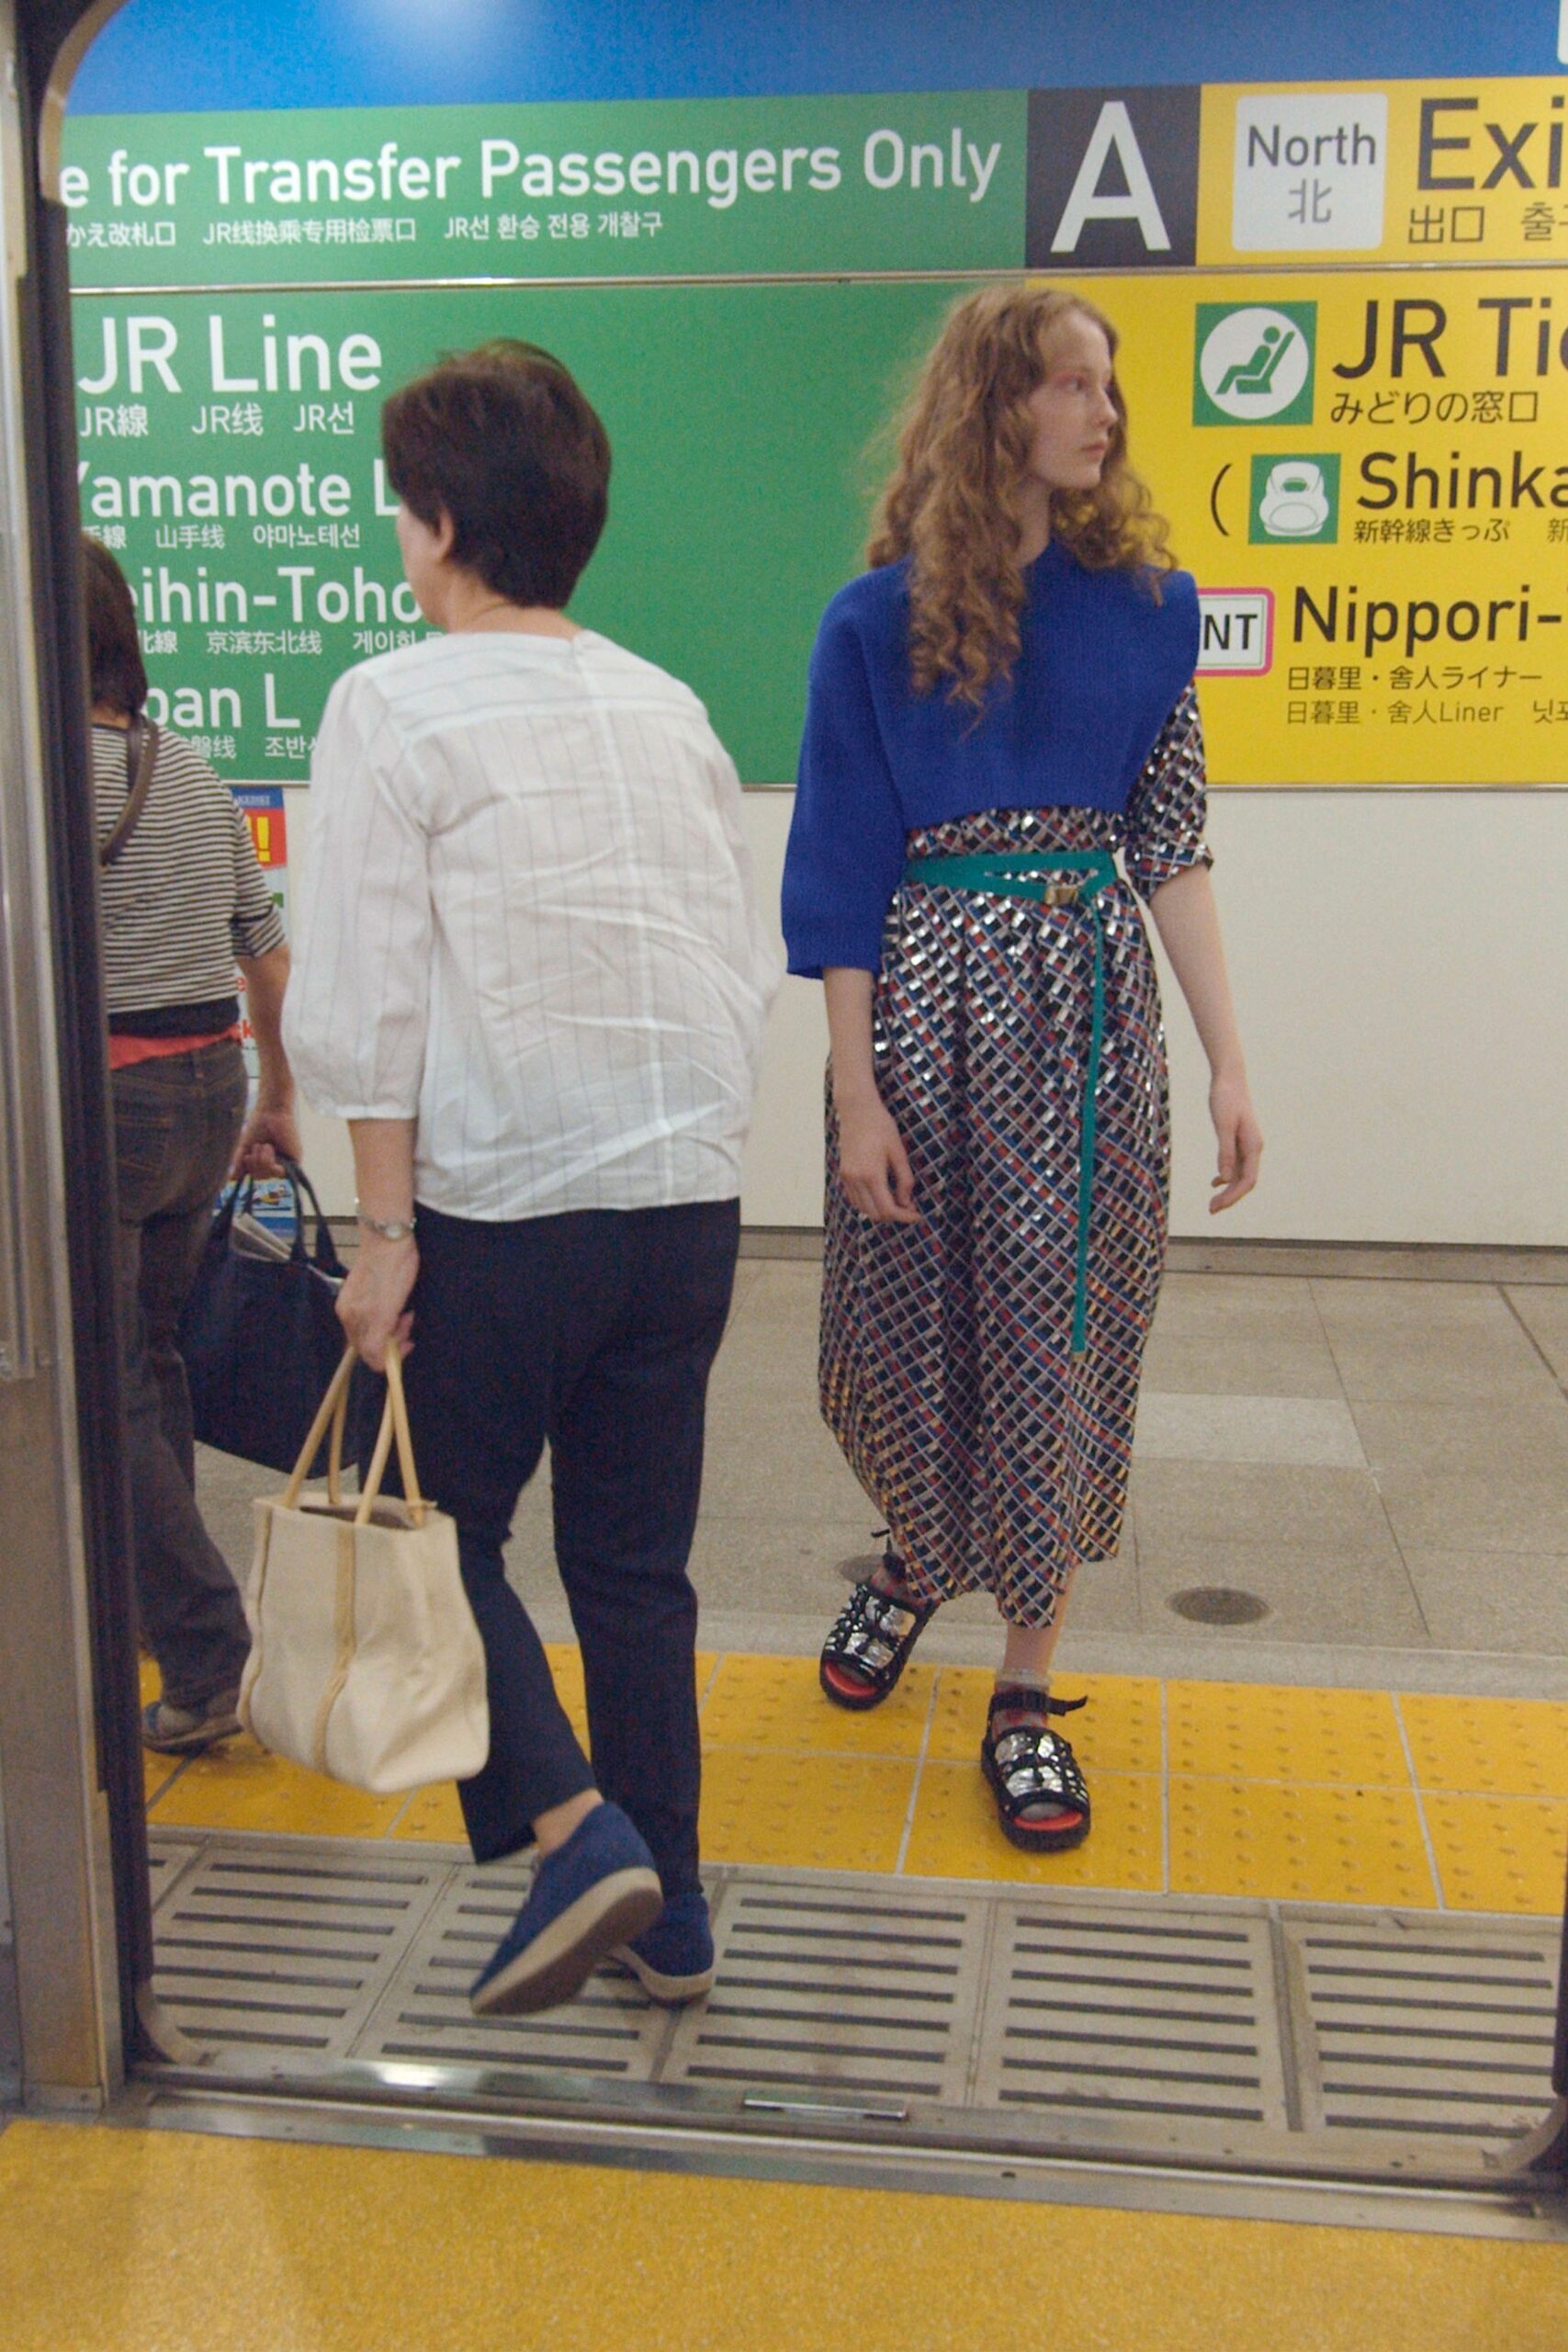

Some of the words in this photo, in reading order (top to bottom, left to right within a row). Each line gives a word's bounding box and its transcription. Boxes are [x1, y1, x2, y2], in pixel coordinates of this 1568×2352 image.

[1247, 122, 1376, 167] North
[1417, 96, 1565, 190] Exi
[107, 149, 190, 206] for
[203, 142, 461, 204] Transfer
[481, 139, 841, 209] Passengers
[863, 128, 1001, 202] Only
[1051, 101, 1171, 253] A
[1287, 178, 1332, 224] 北
[1521, 201, 1568, 241] 출
[445, 215, 489, 240] JR선
[598, 211, 662, 237] 개찰구
[1408, 205, 1485, 243] 出口
[77, 316, 182, 393] JR
[209, 314, 382, 392] Line
[1332, 300, 1447, 379] JR
[1478, 297, 1568, 376] Ti
[80, 404, 149, 437] JR線
[293, 401, 355, 435] JR선
[1330, 390, 1539, 424] みどりの窓口
[253, 523, 360, 549] 야마노테선
[1354, 517, 1511, 543] 新幹線きっぷ
[128, 566, 423, 624] ihin-Toho
[1203, 613, 1258, 650] NT
[265, 673, 301, 728] L
